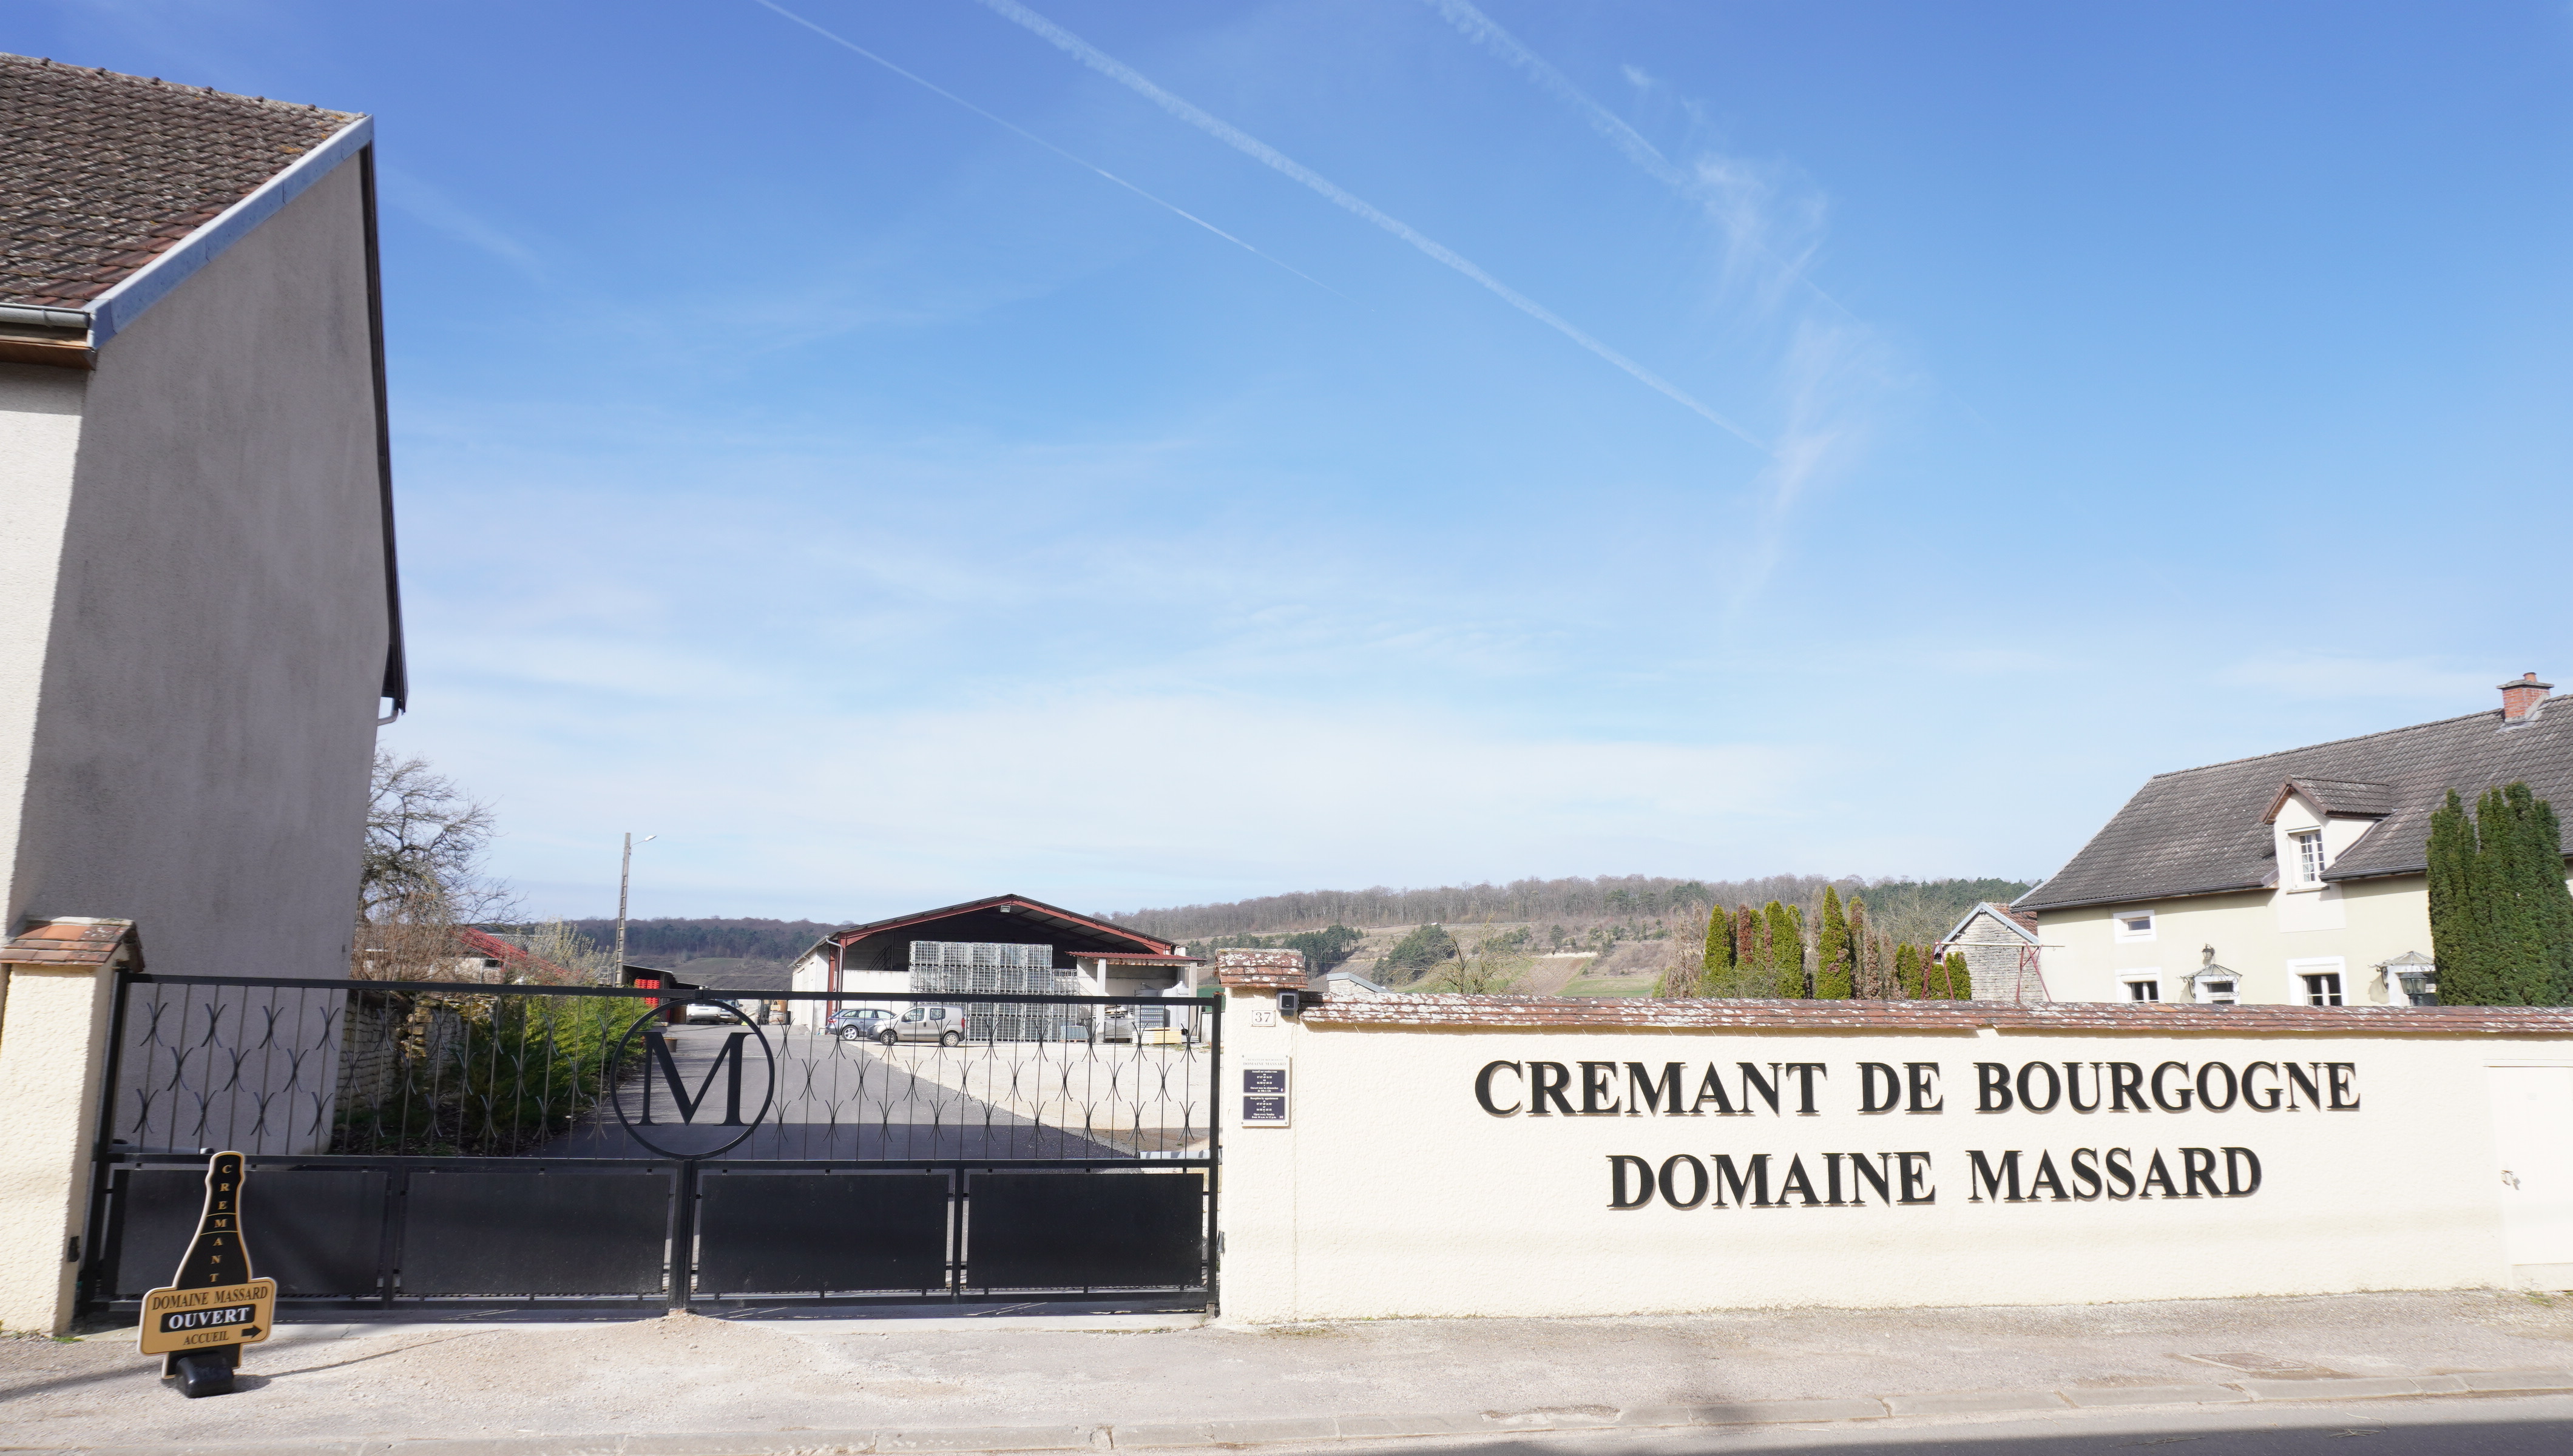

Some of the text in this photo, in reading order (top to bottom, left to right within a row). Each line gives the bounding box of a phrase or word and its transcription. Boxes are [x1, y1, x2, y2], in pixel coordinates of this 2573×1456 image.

[1255, 1012, 1271, 1023] 37
[629, 1031, 758, 1127] M
[1475, 1060, 2361, 1115] CREMANT DE BOURGOGNE
[1611, 1147, 2262, 1208] DOMAINE MASSARD
[209, 1164, 232, 1282] CREMANT
[152, 1286, 268, 1310] DOMAINE MASSARD
[169, 1307, 250, 1329] OUVERT
[183, 1330, 229, 1346] ACCUEIL
